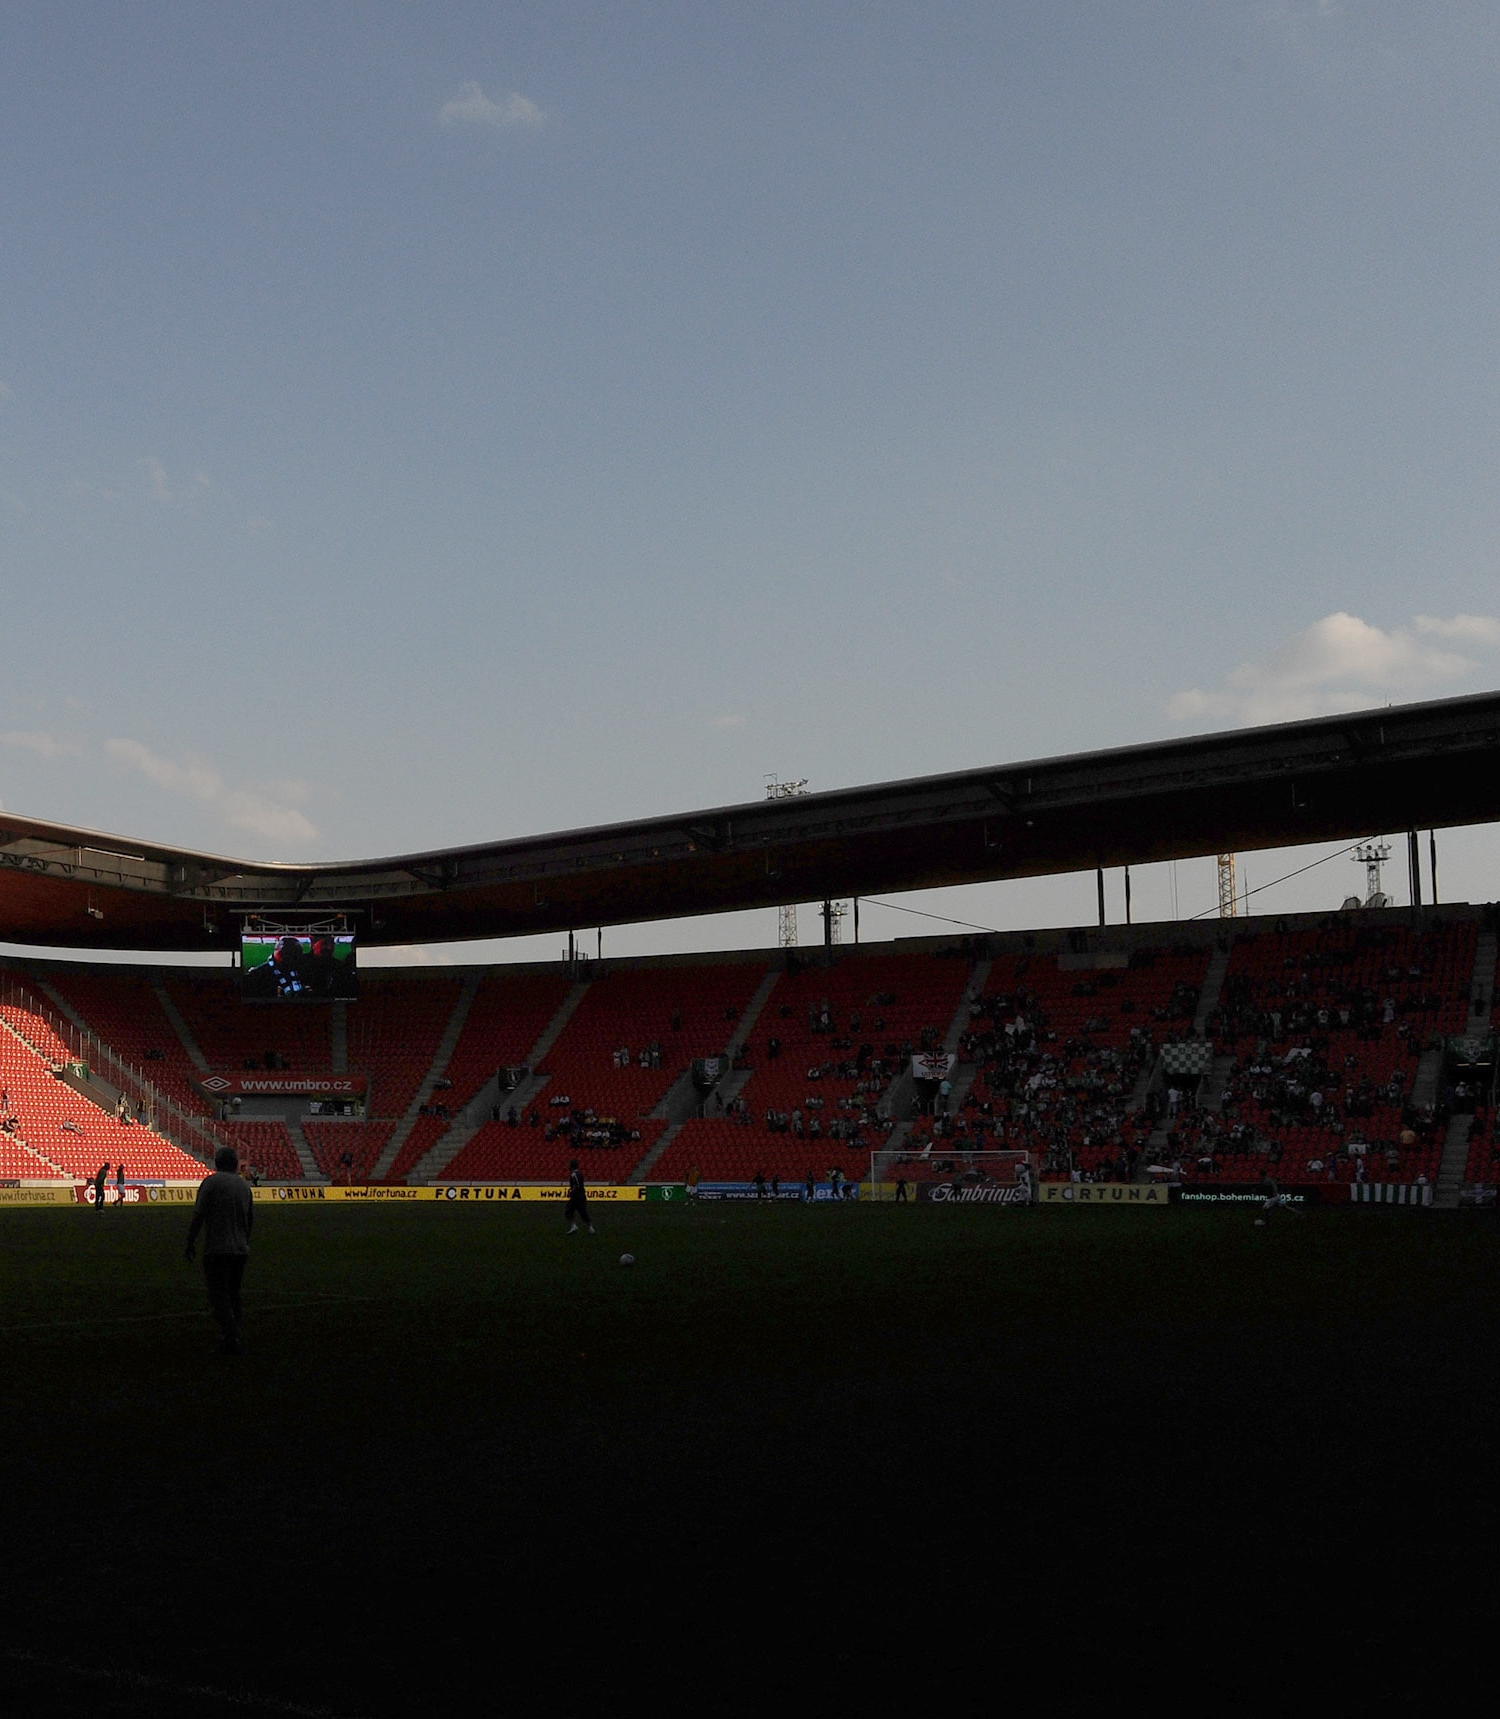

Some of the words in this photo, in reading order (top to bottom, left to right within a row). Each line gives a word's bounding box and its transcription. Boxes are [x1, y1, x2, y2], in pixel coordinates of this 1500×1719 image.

[241, 1079, 352, 1091] www.umbro.cz
[272, 1187, 325, 1200] FORTUNA
[344, 1188, 417, 1198] www.ifortuna.cz
[435, 1187, 522, 1200] FORTUNA
[1047, 1187, 1158, 1200] FORTUNA
